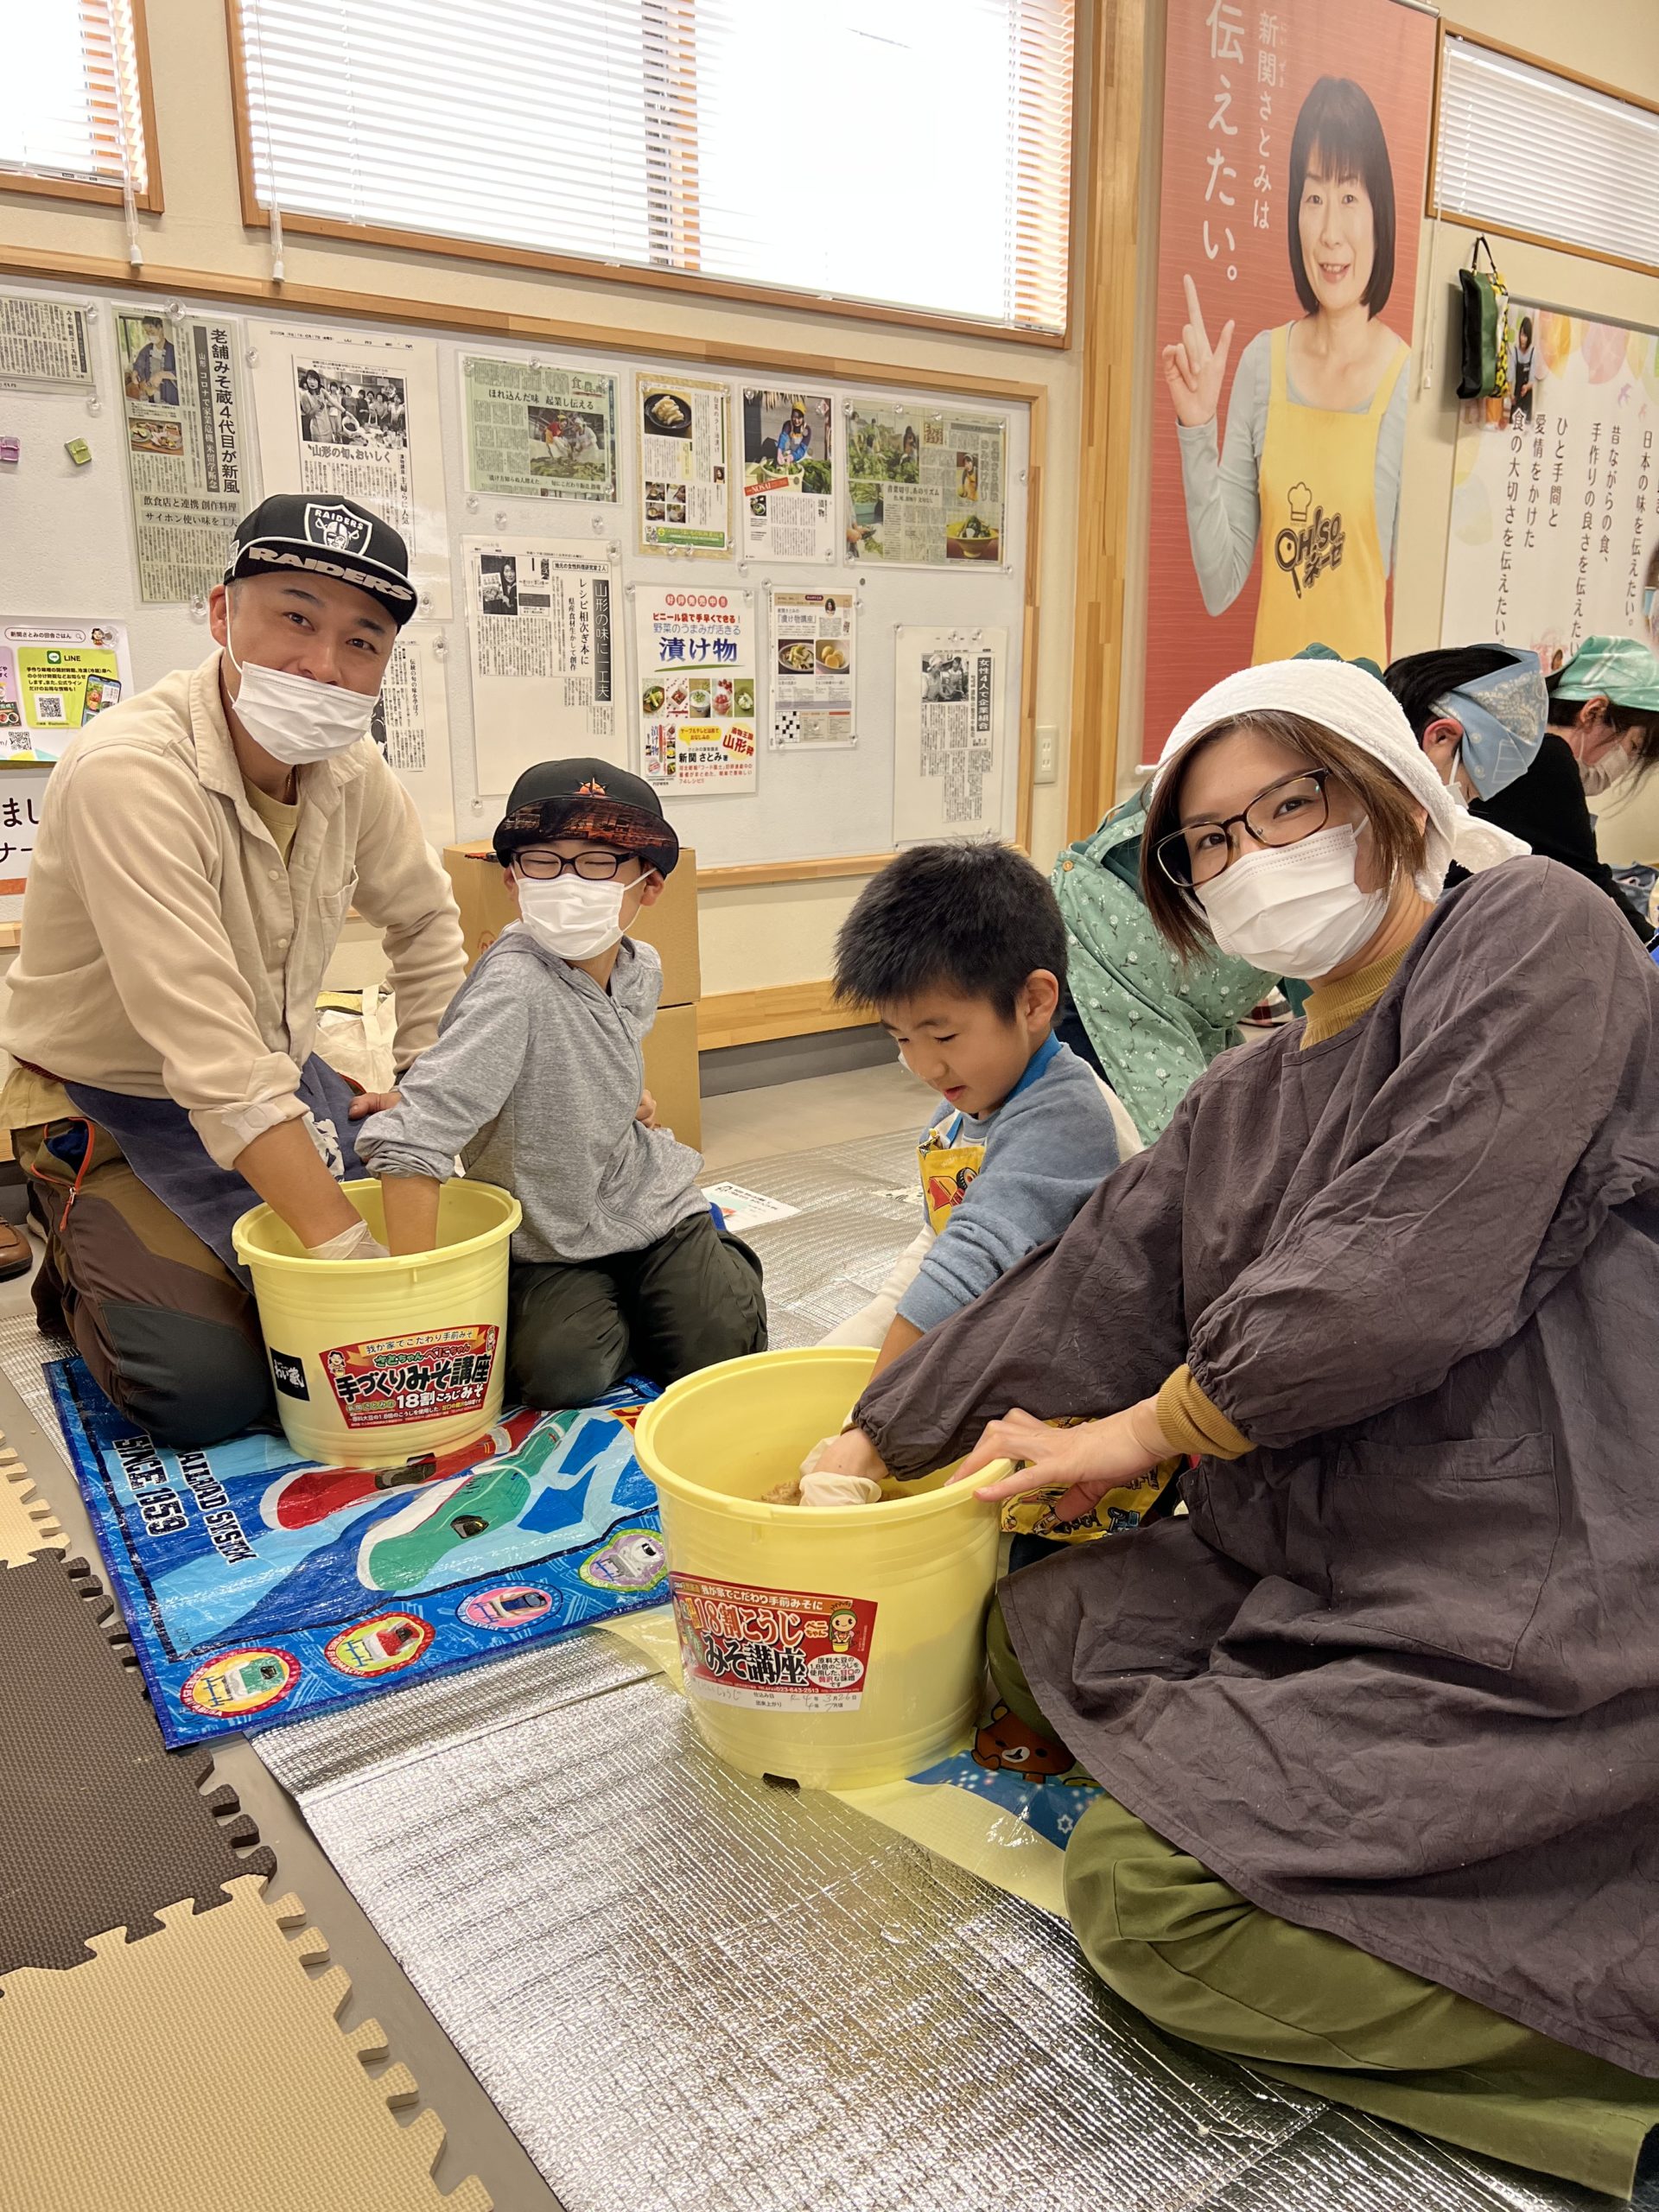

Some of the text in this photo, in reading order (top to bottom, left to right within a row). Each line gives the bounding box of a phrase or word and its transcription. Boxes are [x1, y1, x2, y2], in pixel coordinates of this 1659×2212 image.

[1254, 10, 1278, 230] 新関さとみは
[211, 328, 240, 494] 老舗みそ蔵4代目が新風
[488, 389, 594, 410] ほれ込んだ味 起業し伝える
[1524, 414, 1547, 549] 愛情をかけた
[1548, 416, 1568, 528] ひと手間と
[143, 495, 238, 512] 飲食店と連携 創作料理
[145, 512, 238, 528] サイホン使い味を工夫
[315, 509, 364, 531] RAIDERS
[1624, 430, 1653, 627] 日本の味を伝えたい。
[249, 546, 414, 601] RAIDERS
[579, 578, 590, 665] レシピ相次ぎ本に
[594, 583, 610, 699] 山形の味に一工夫
[653, 622, 741, 636] 野菜のうまみが活きる
[658, 636, 738, 663] 漬け物
[365, 1331, 473, 1355] 我が家でこだわり手前みそ
[334, 1353, 493, 1404] 手づくりみそ講座
[112, 1434, 189, 1537] SINCE 1959
[701, 1584, 823, 1611] 我が家でこだわり手前みそに
[701, 1630, 810, 1687] みそ講座
